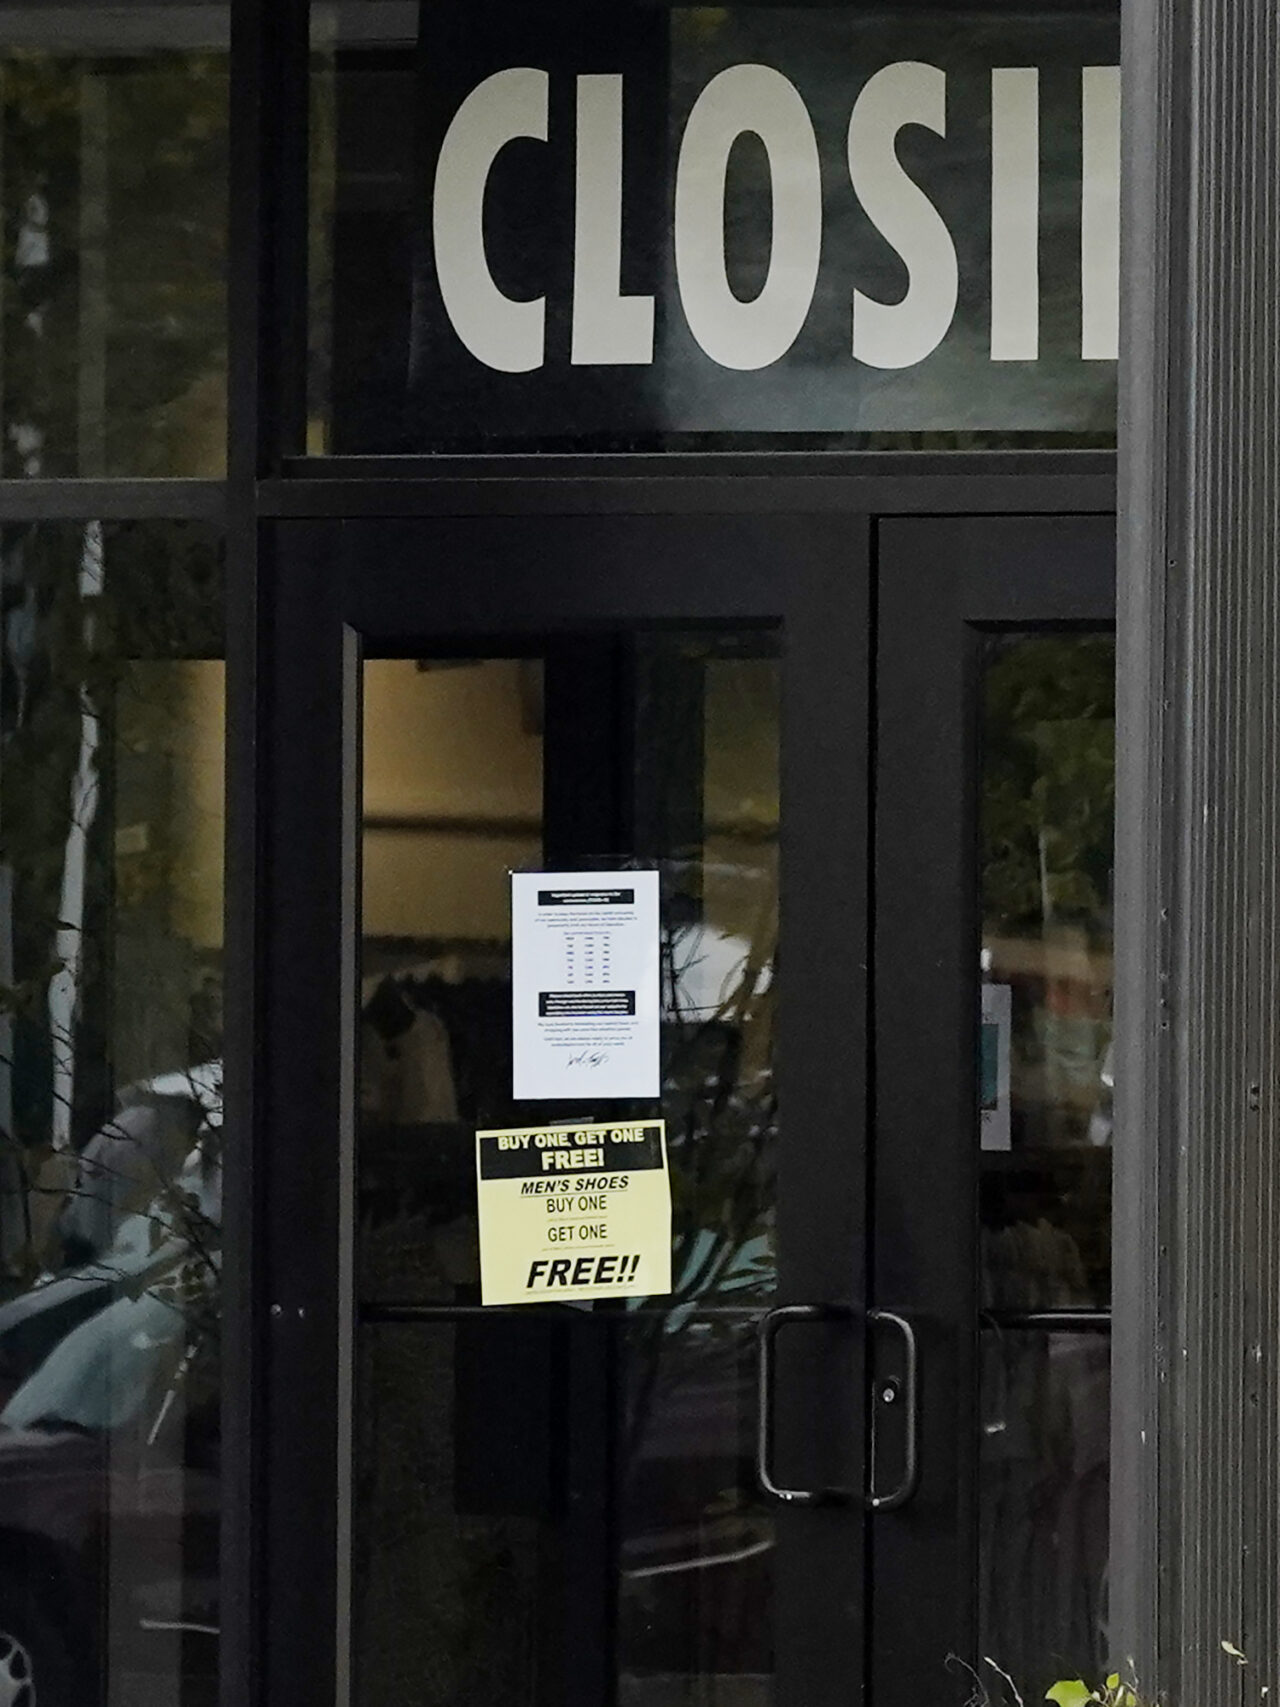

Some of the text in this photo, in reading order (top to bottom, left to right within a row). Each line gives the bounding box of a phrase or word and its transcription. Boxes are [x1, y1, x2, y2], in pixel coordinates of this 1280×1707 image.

[498, 1135, 531, 1150] BUY
[574, 1130, 607, 1146] GET
[610, 1128, 644, 1143] ONE
[541, 1148, 605, 1171] FREE!
[521, 1175, 629, 1195] MEN'S SHOES
[546, 1195, 607, 1213] BUY ONE
[548, 1224, 607, 1242] GET ONE
[526, 1254, 640, 1288] FREE!!
